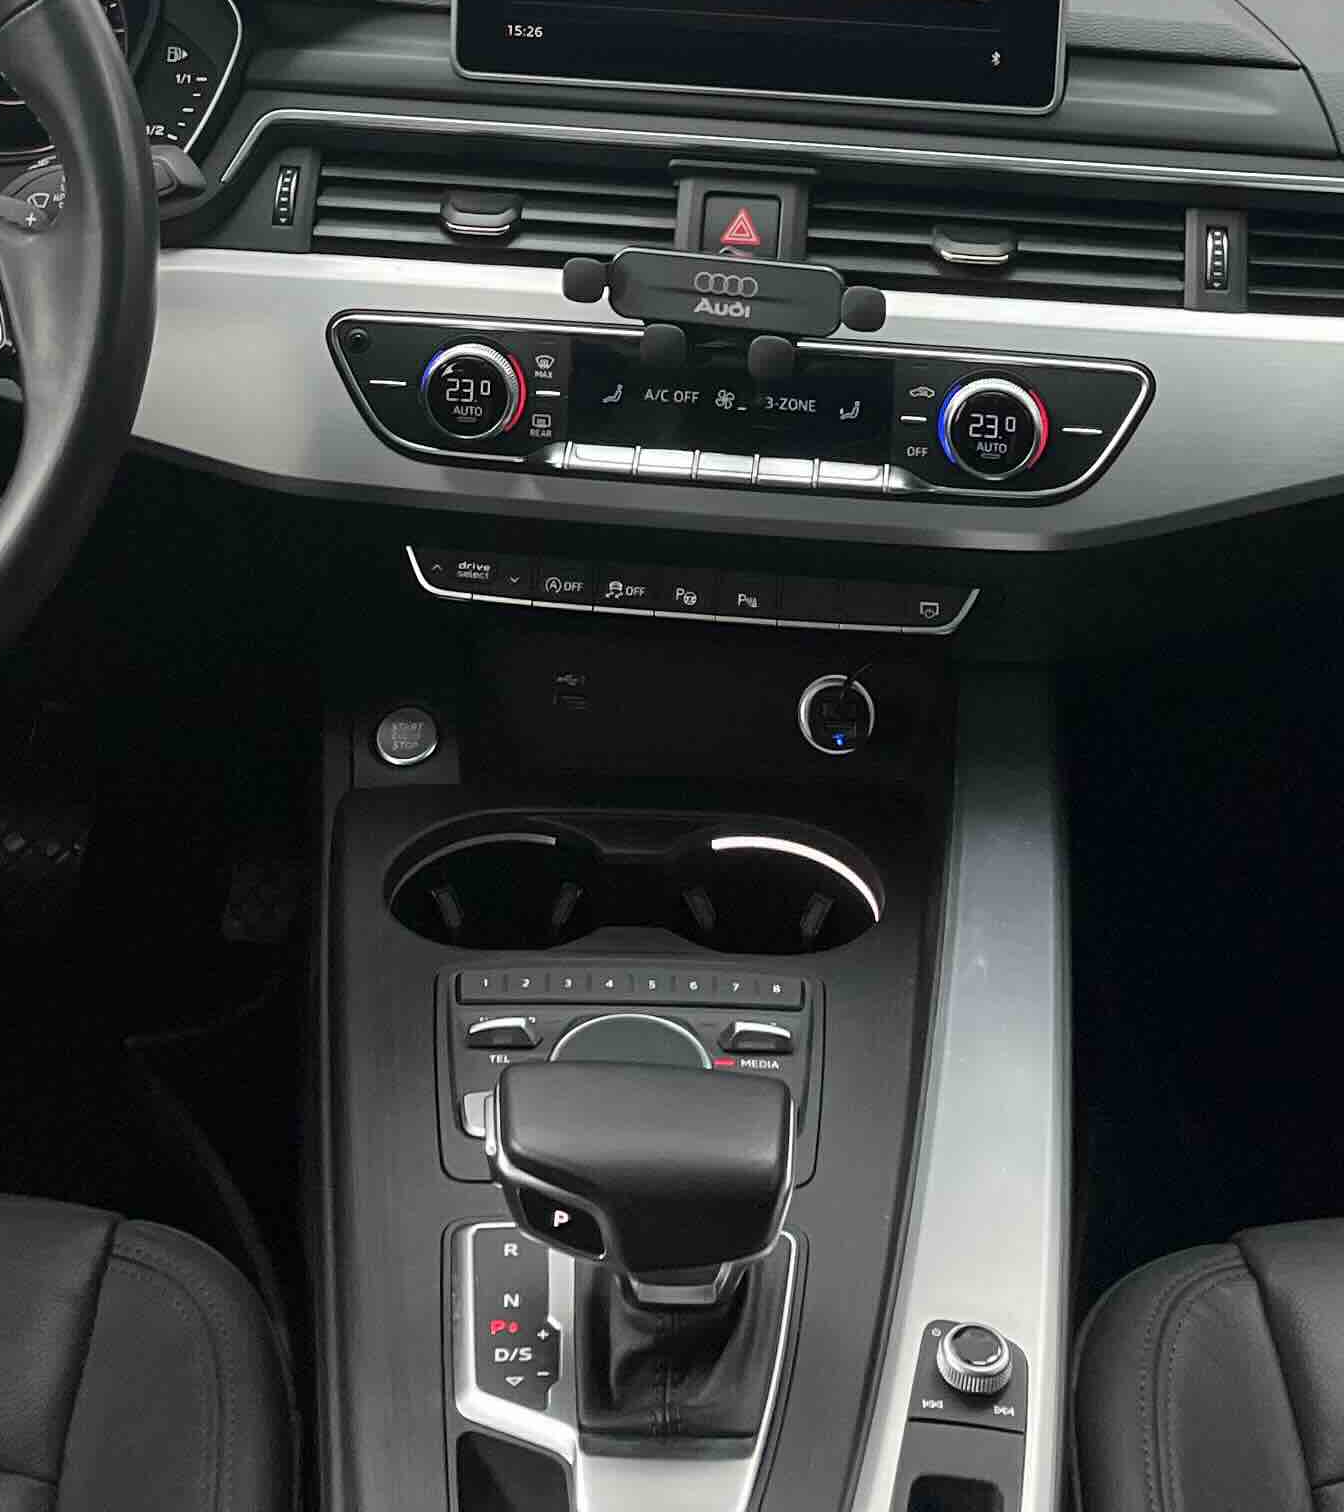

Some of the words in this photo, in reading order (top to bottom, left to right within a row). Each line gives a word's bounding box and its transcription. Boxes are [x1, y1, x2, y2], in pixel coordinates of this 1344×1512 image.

[506, 24, 544, 38] 15:26
[693, 297, 752, 319] Audi
[534, 369, 553, 380] MAX
[644, 389, 669, 403] A/C
[673, 390, 700, 405] OFF
[764, 396, 817, 414] 3-ZONE
[452, 406, 483, 418] AUTO
[906, 446, 928, 458] OFF
[976, 441, 1008, 455] AUTO
[458, 561, 491, 573] drive
[563, 581, 584, 593] OFF
[625, 585, 645, 597] OFF
[483, 979, 489, 988] 1
[522, 979, 530, 988] 2
[564, 979, 573, 988] 3
[605, 979, 613, 989] 4
[648, 979, 656, 990] 5
[689, 980, 698, 990] 6
[732, 982, 740, 992] 7
[489, 1054, 510, 1064] TEL
[740, 1058, 780, 1070] MEDIA
[553, 1209, 570, 1227] P
[504, 1243, 519, 1257] R
[503, 1293, 520, 1308] N
[494, 1347, 533, 1363] D/S
